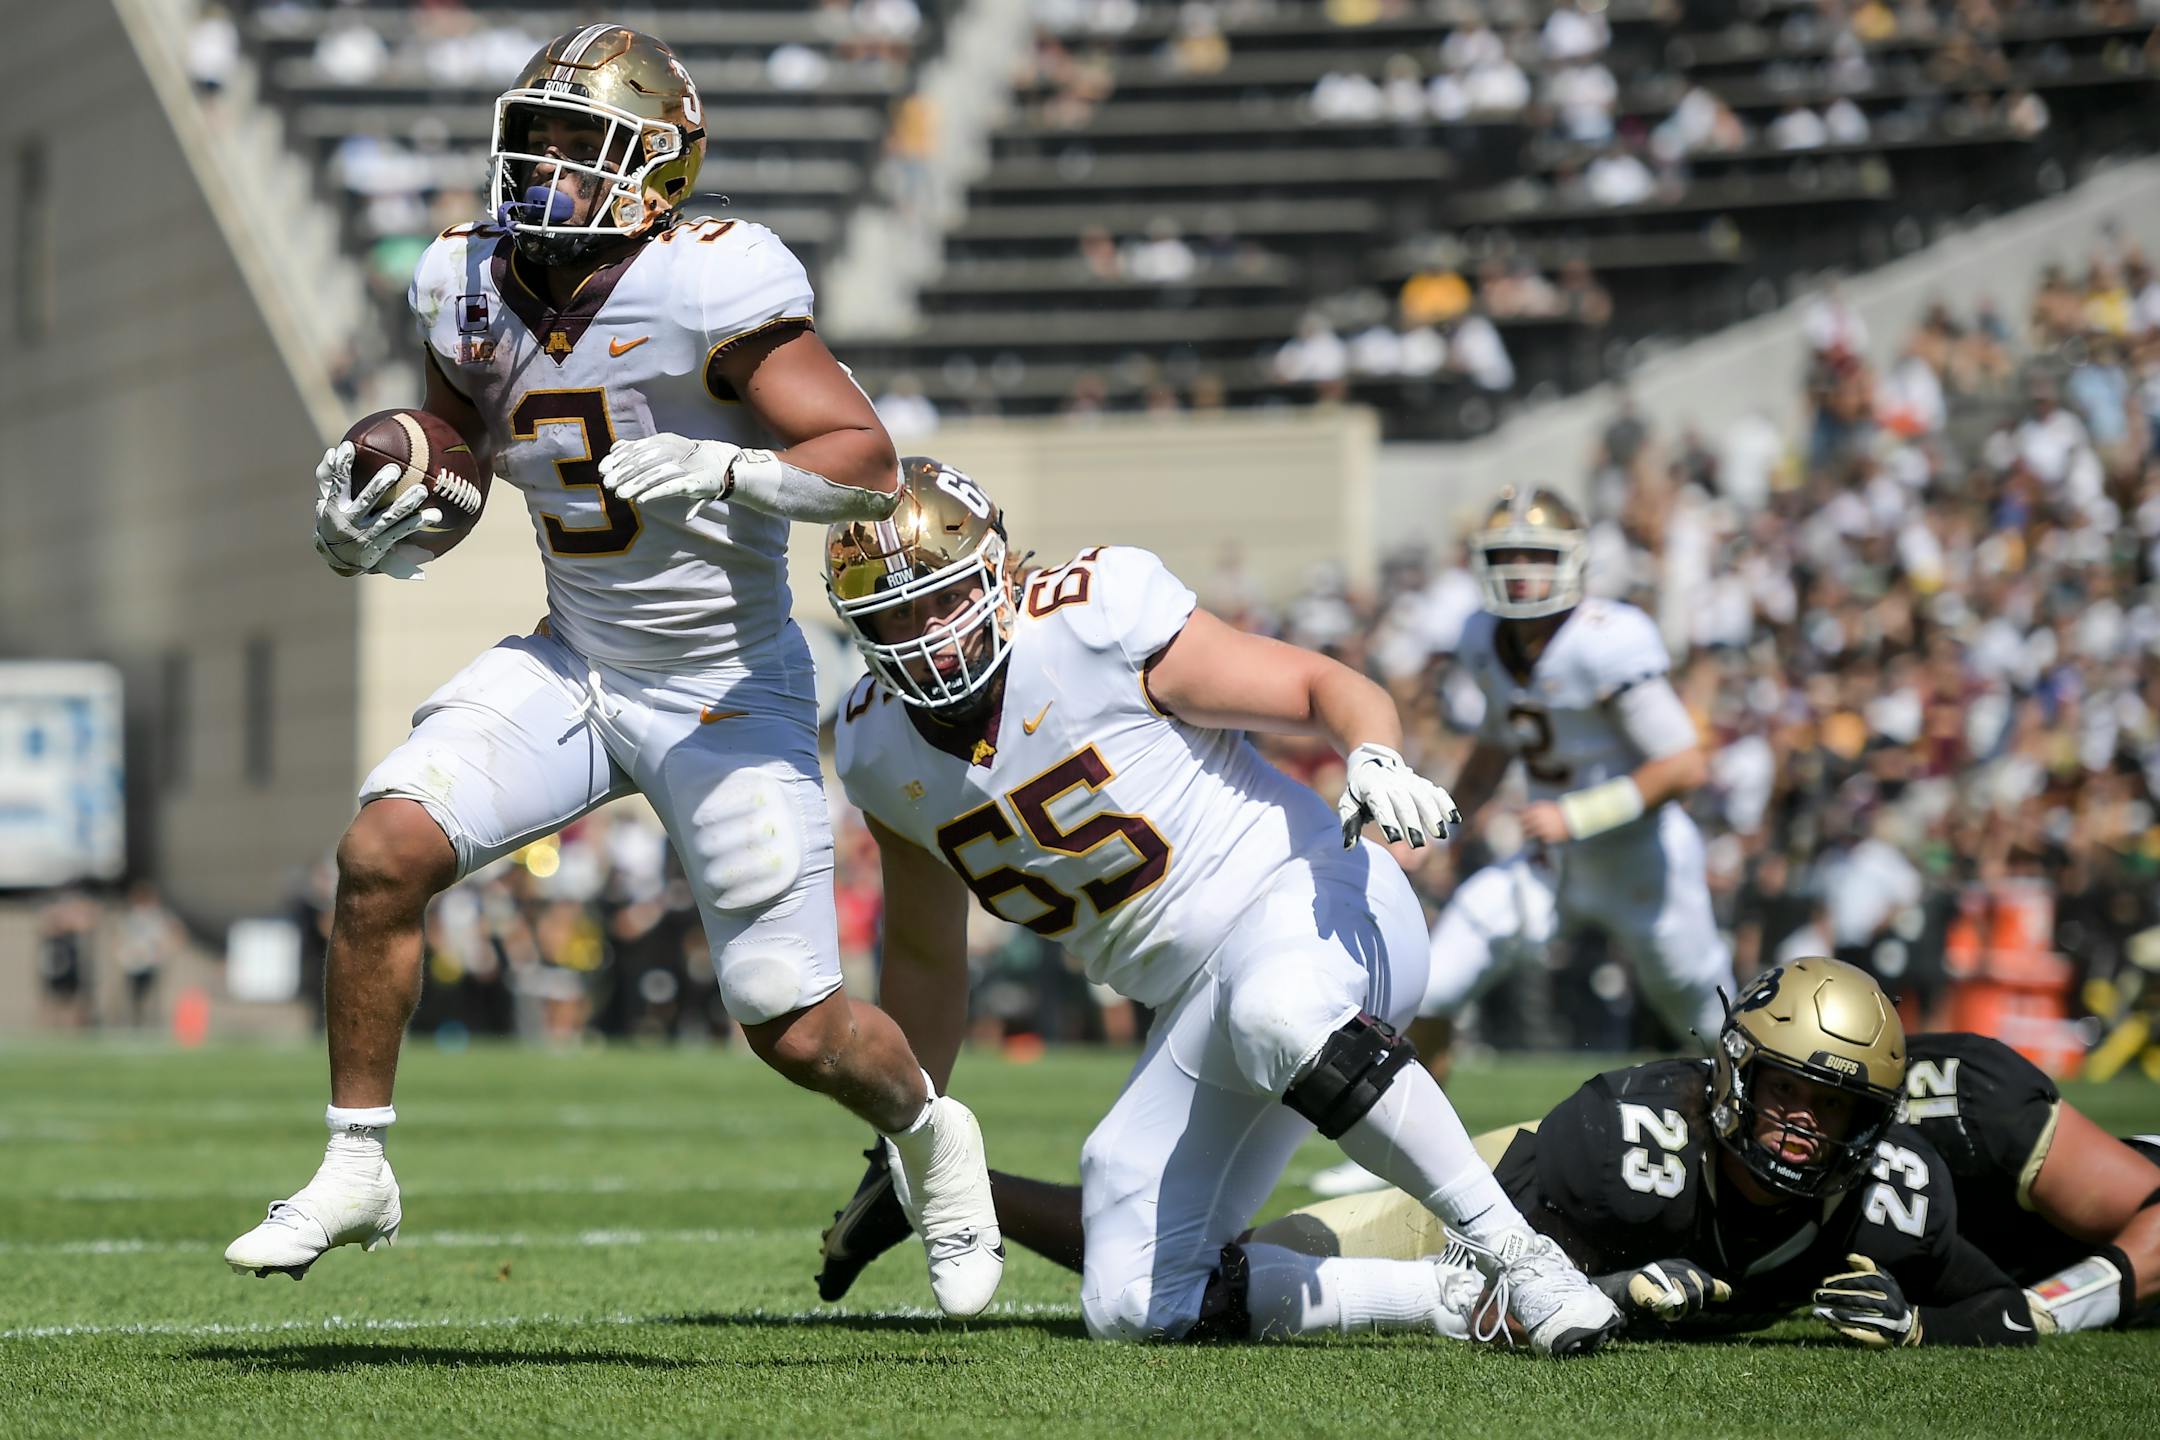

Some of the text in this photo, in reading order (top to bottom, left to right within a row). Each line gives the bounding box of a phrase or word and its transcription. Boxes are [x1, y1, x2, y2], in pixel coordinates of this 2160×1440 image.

[544, 80, 573, 94] ROW
[667, 57, 702, 126] 3
[508, 386, 644, 557] 3
[886, 568, 914, 589] ROW
[1505, 703, 1573, 787] 2
[936, 741, 1173, 935] 65
[1825, 1055, 1859, 1076] BUFFS
[1906, 1057, 1960, 1126] 12
[1621, 1102, 1689, 1199] 23
[1864, 1140, 1930, 1238] 23
